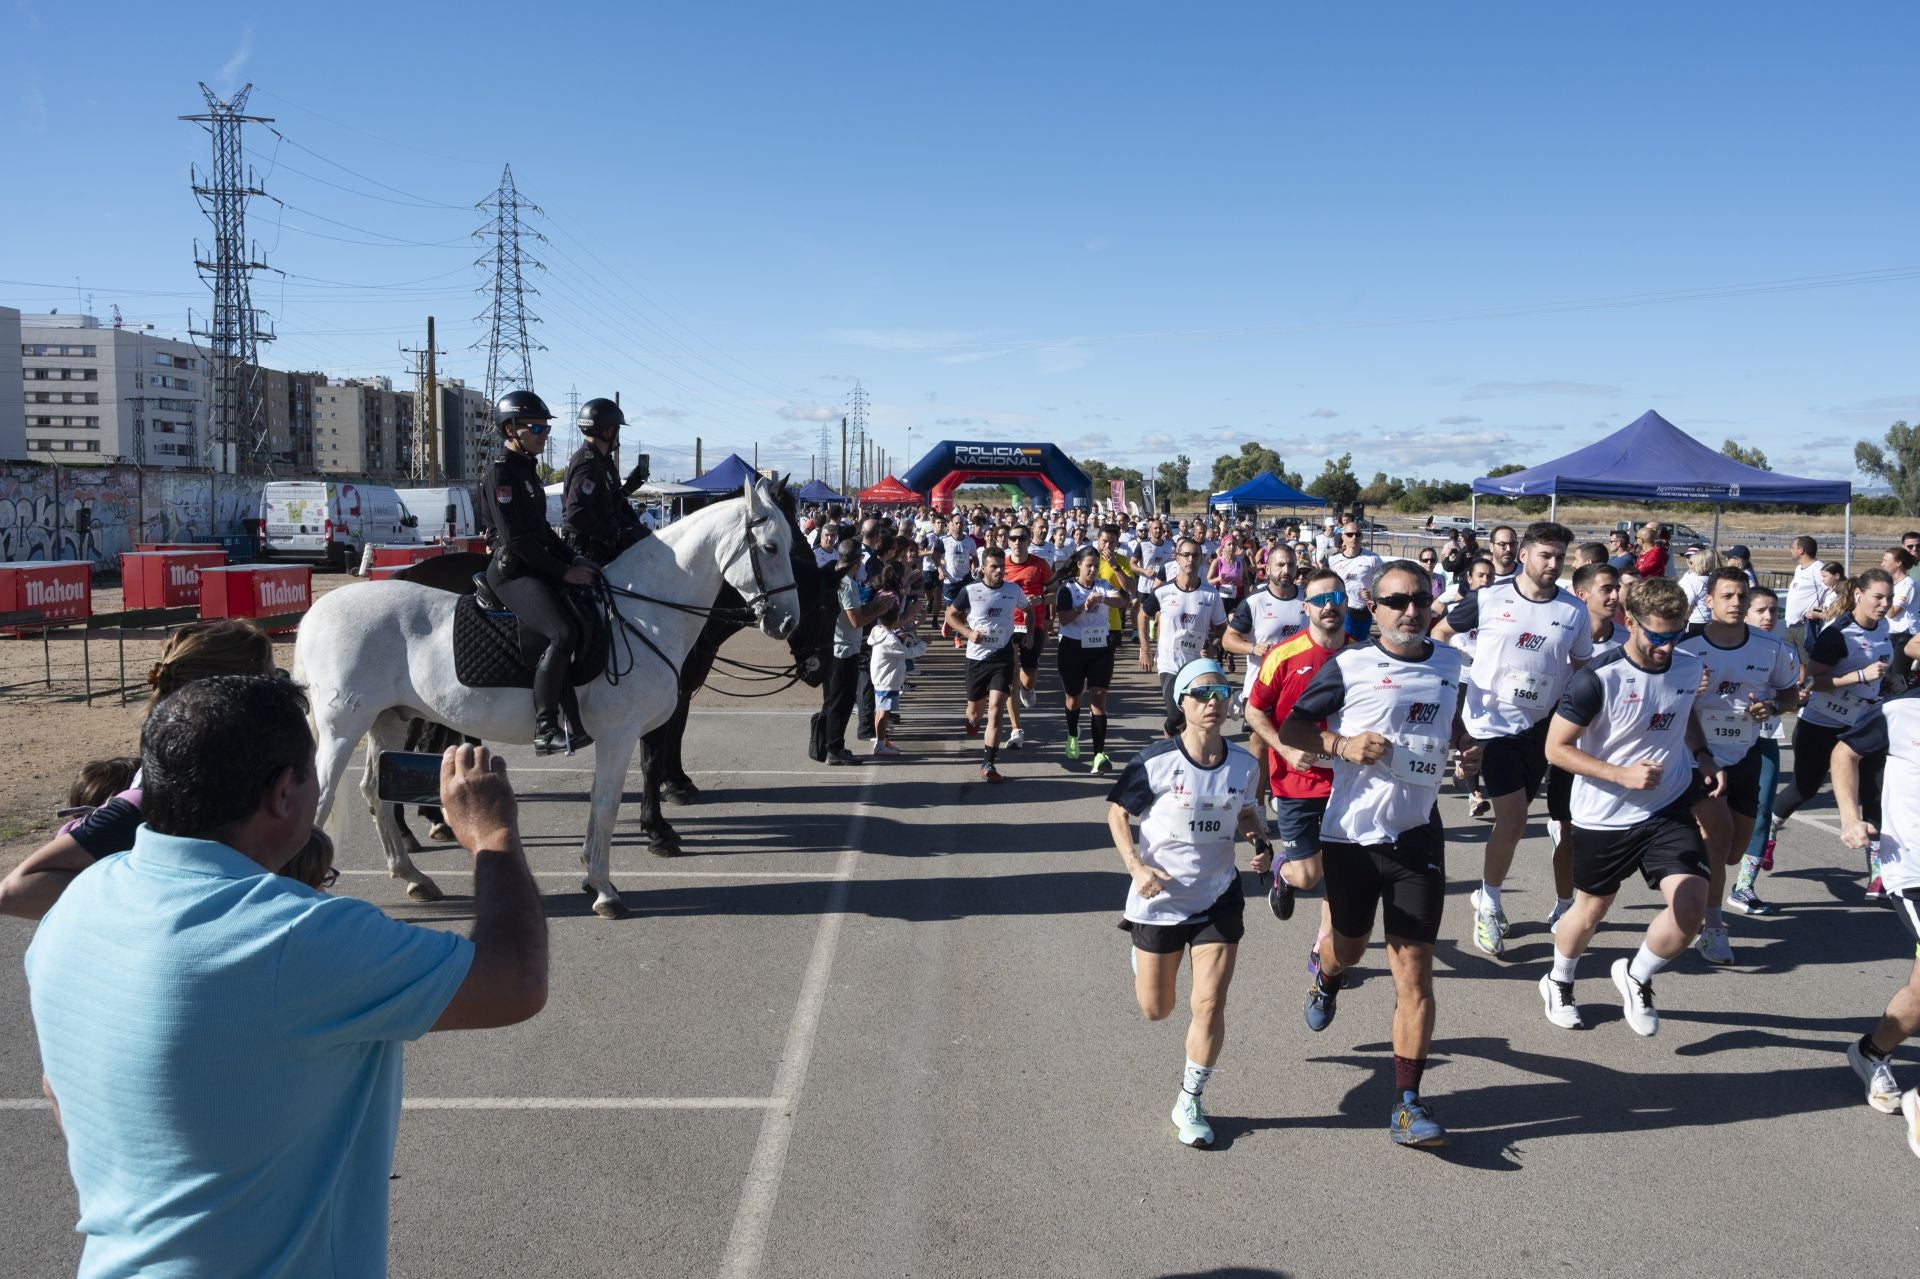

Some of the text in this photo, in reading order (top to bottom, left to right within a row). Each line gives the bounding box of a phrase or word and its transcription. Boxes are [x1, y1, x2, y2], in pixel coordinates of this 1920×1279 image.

[955, 446, 1024, 456] POLICIA
[955, 456, 1041, 466] NACIONAL
[26, 579, 84, 606] Mahou
[260, 579, 307, 607] Mahou
[1181, 640, 1196, 648] 1054
[1513, 688, 1538, 700] 1506
[1826, 701, 1848, 715] 1133
[1714, 728, 1741, 737] 1399
[1409, 760, 1437, 774] 1245
[1188, 820, 1221, 832] 1180
